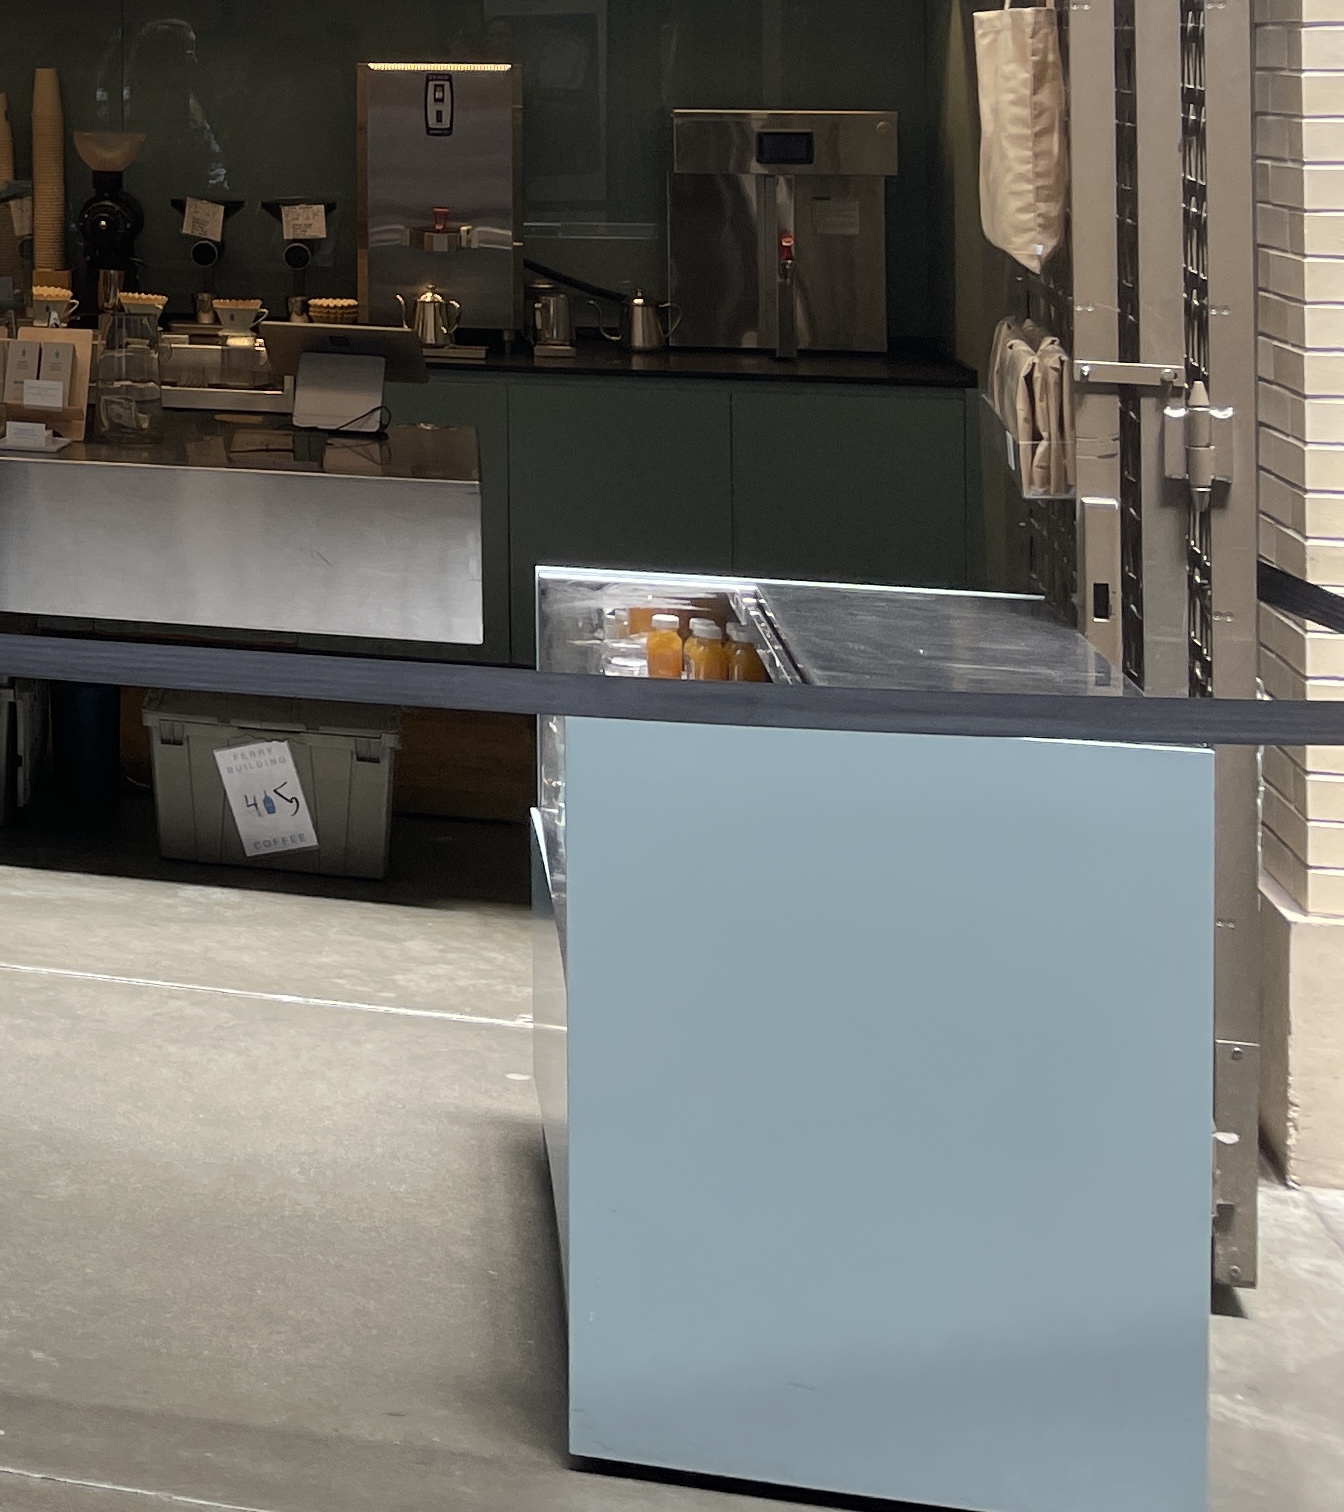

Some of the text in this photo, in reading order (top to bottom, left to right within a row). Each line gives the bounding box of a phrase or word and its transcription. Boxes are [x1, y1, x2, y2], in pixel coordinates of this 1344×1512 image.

[233, 747, 273, 761] FERRY
[226, 756, 286, 774] BUILDING
[244, 794, 262, 818] 4
[253, 833, 306, 849] COFFEE
